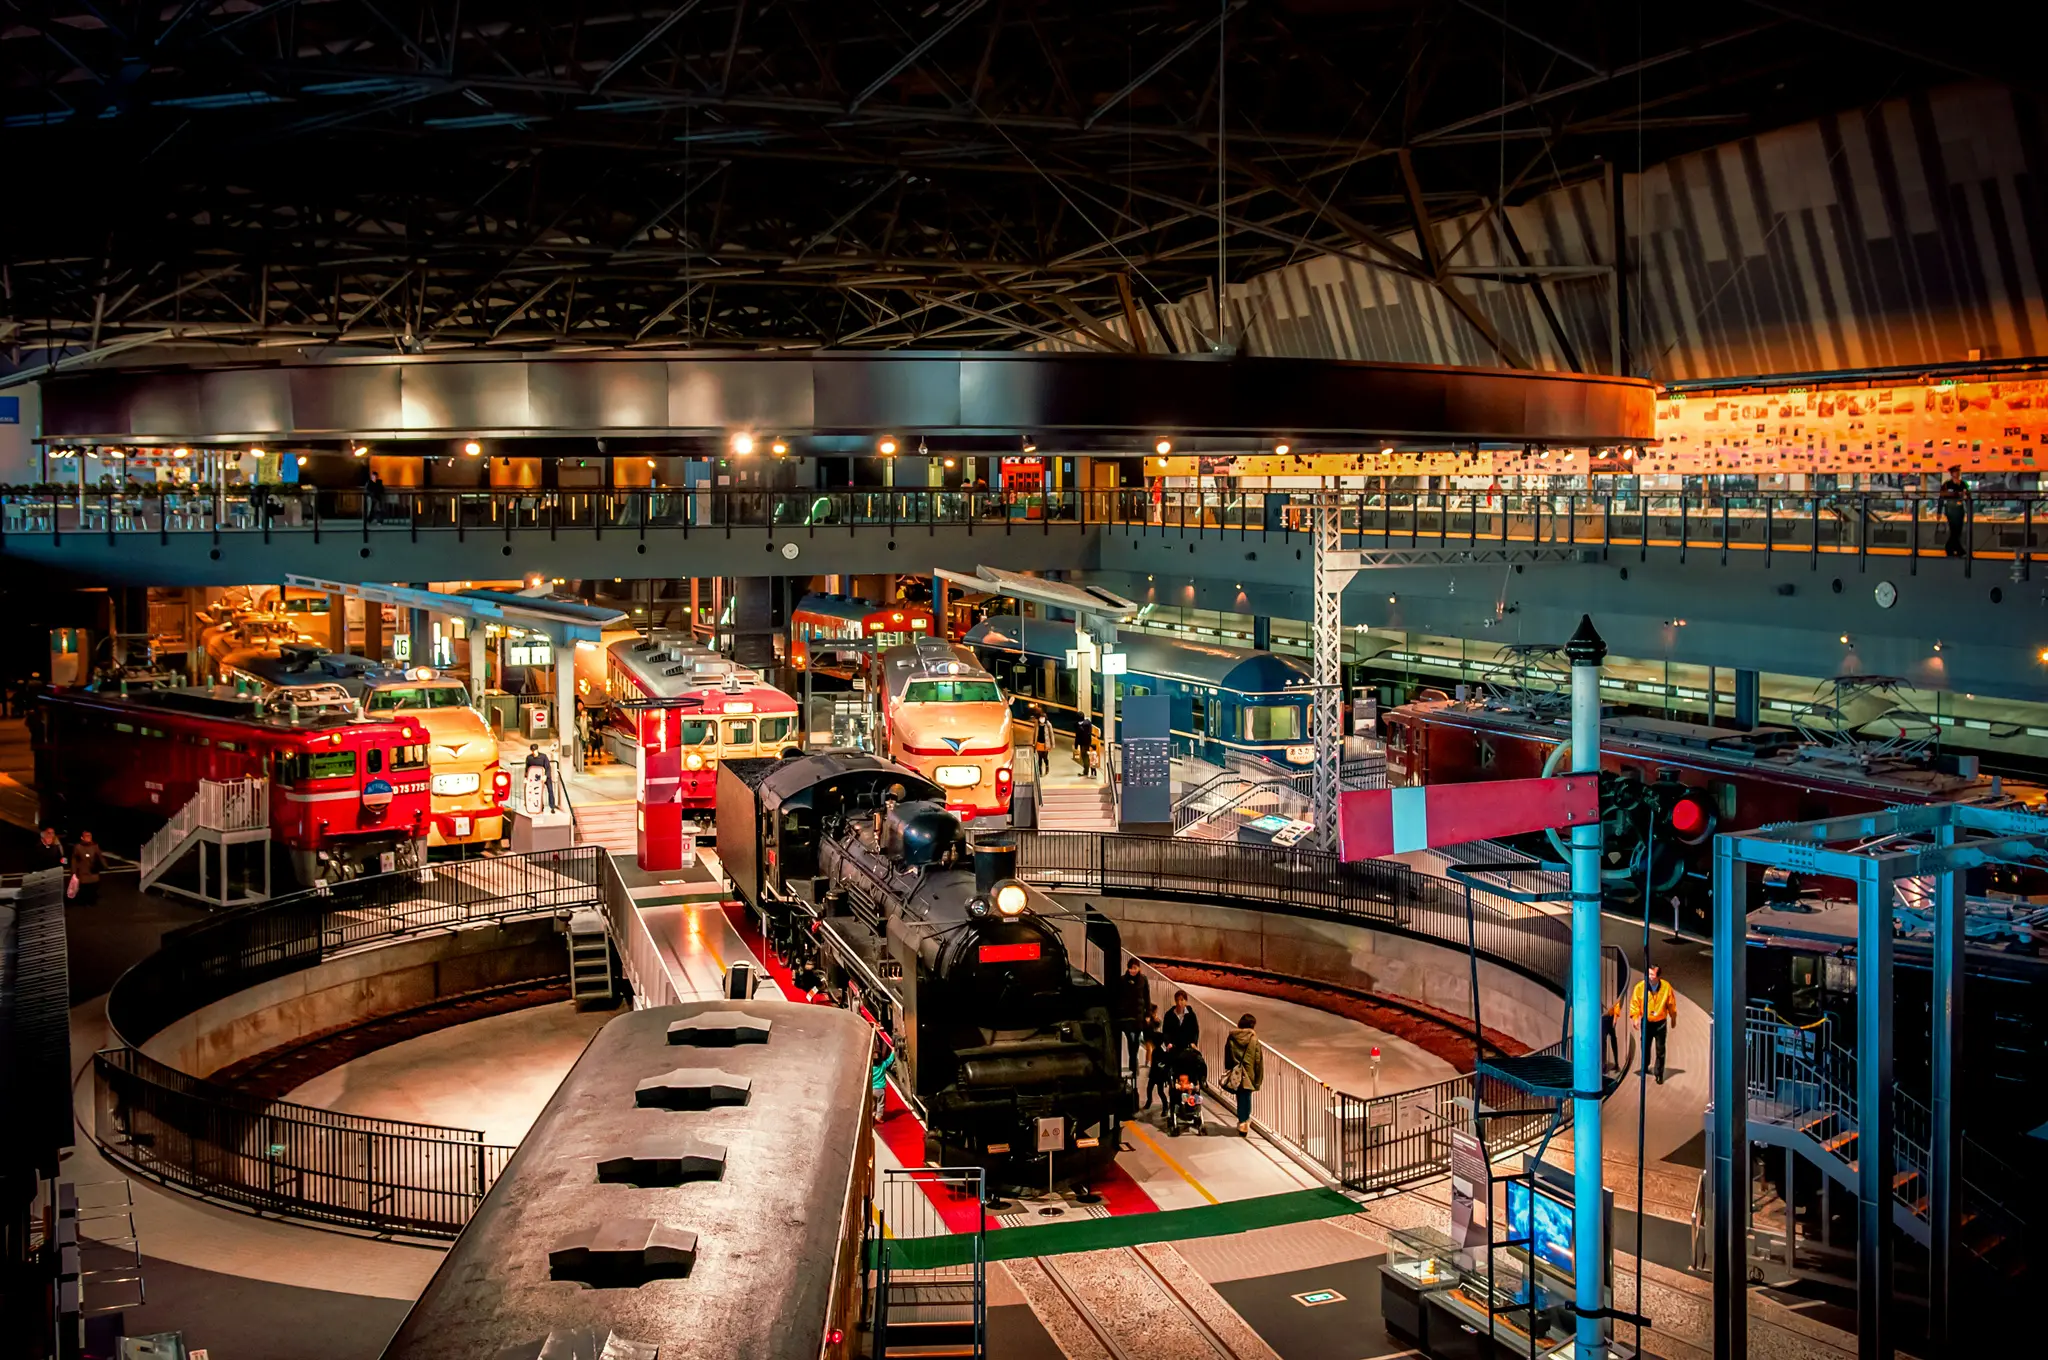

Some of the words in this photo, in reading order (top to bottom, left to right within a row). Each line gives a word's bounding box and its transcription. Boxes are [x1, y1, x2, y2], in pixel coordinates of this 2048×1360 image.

[396, 639, 407, 656] 16
[399, 784, 410, 794] 75
[411, 782, 425, 792] 775
